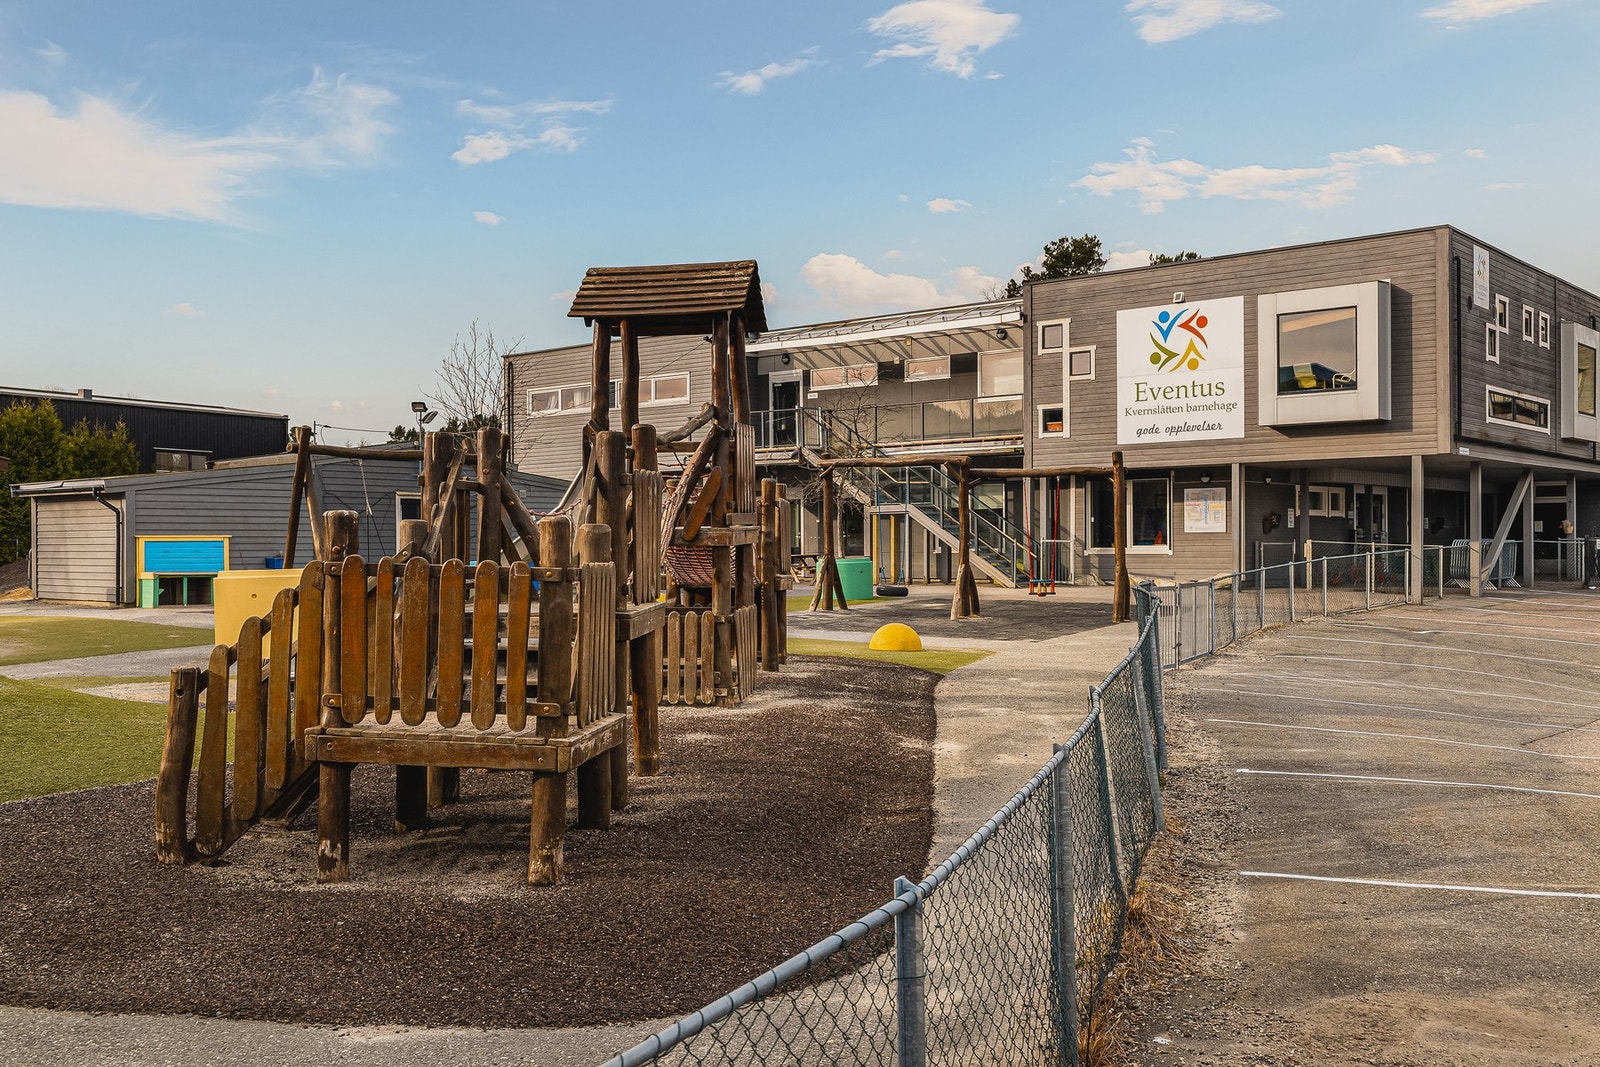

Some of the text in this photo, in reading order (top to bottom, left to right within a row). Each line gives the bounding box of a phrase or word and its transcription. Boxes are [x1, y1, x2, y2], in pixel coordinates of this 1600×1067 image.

[1134, 381, 1225, 402] Eventus
[1125, 401, 1237, 417] Kvernslåtten barnehage
[1136, 421, 1223, 438] gode opplevelser
